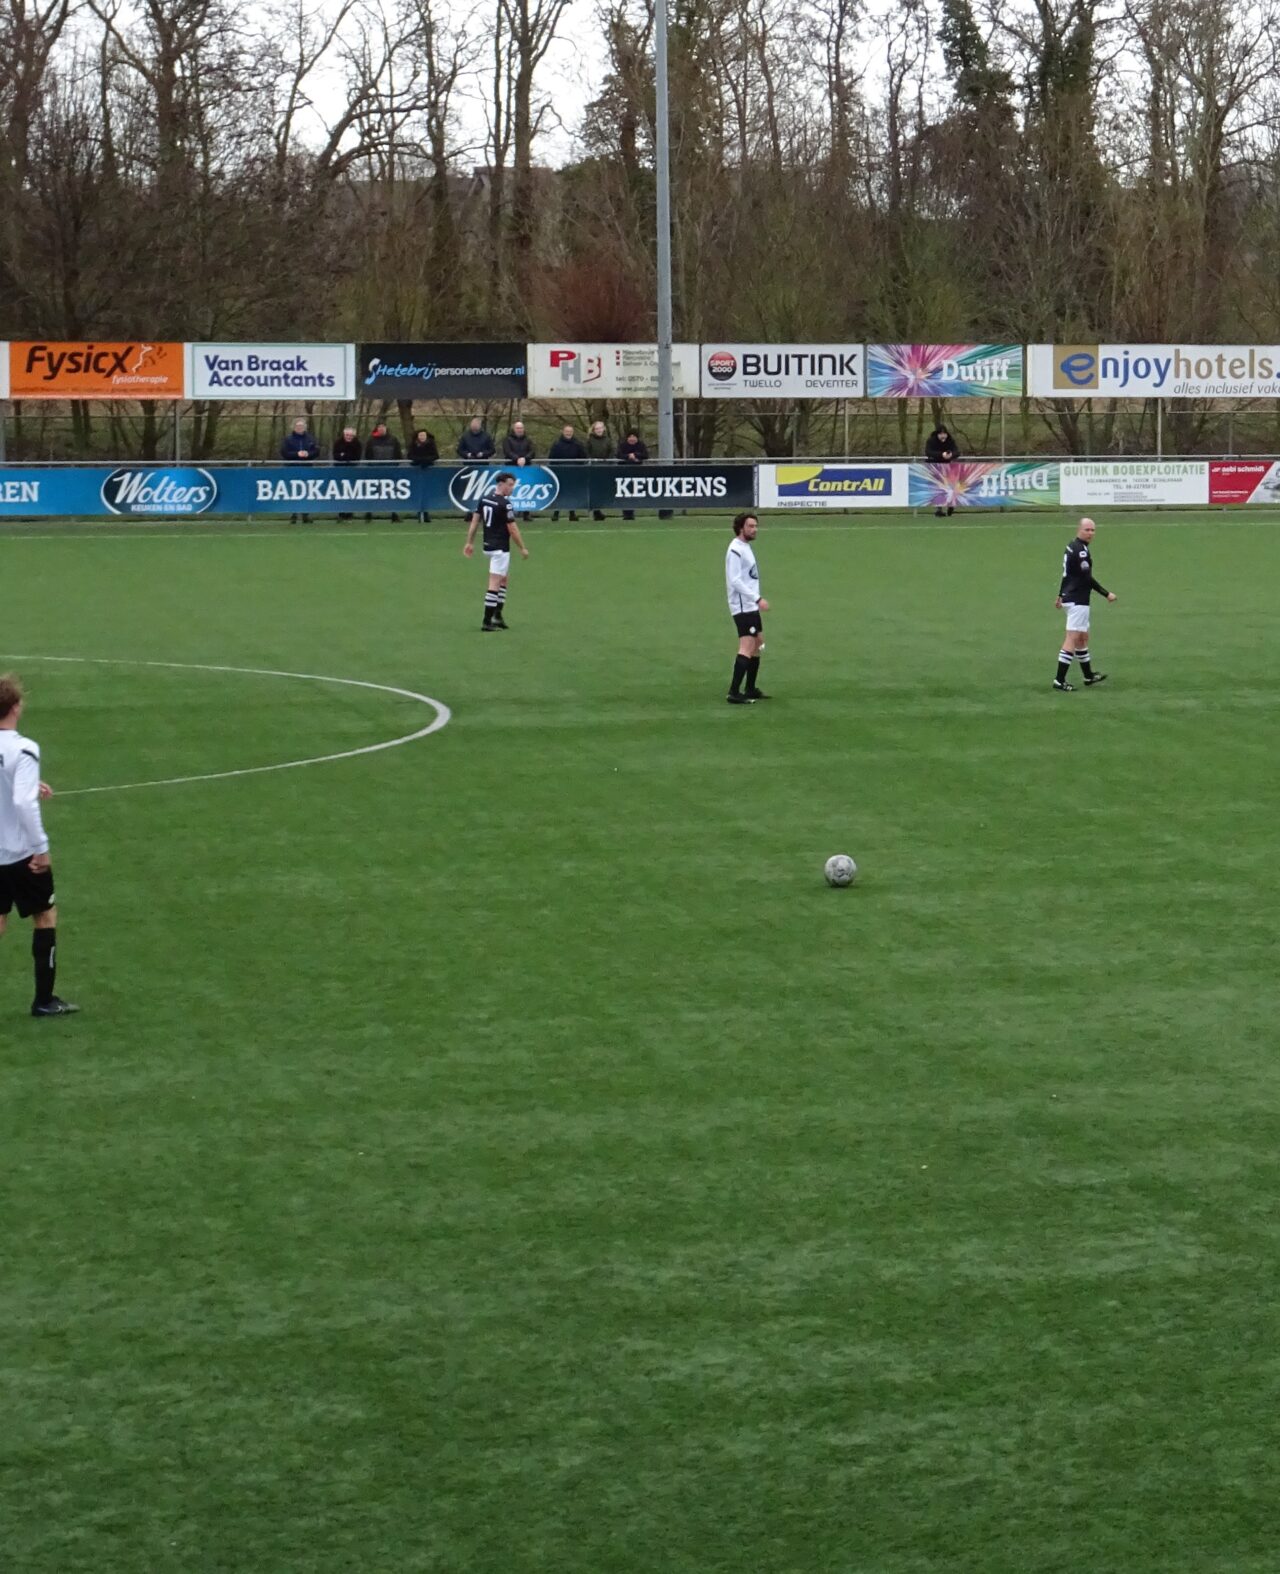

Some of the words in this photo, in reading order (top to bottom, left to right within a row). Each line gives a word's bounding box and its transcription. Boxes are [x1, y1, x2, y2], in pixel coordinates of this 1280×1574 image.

[205, 355, 243, 371] Van
[248, 355, 308, 371] Braak
[742, 354, 857, 376] BUITINK
[209, 371, 335, 387] Accountants
[744, 379, 782, 388] TWELLO
[805, 380, 858, 388] DEVENTER
[1173, 382, 1201, 394] alles
[1204, 381, 1255, 394] inclusief
[1063, 465, 1110, 477] GUITINK
[1112, 464, 1206, 476] BOSEXPLOITATIE
[112, 472, 210, 503] Wolters
[256, 479, 411, 500] BADKAMERS
[615, 476, 727, 497] KEUKENS
[808, 478, 885, 492] ContrAll
